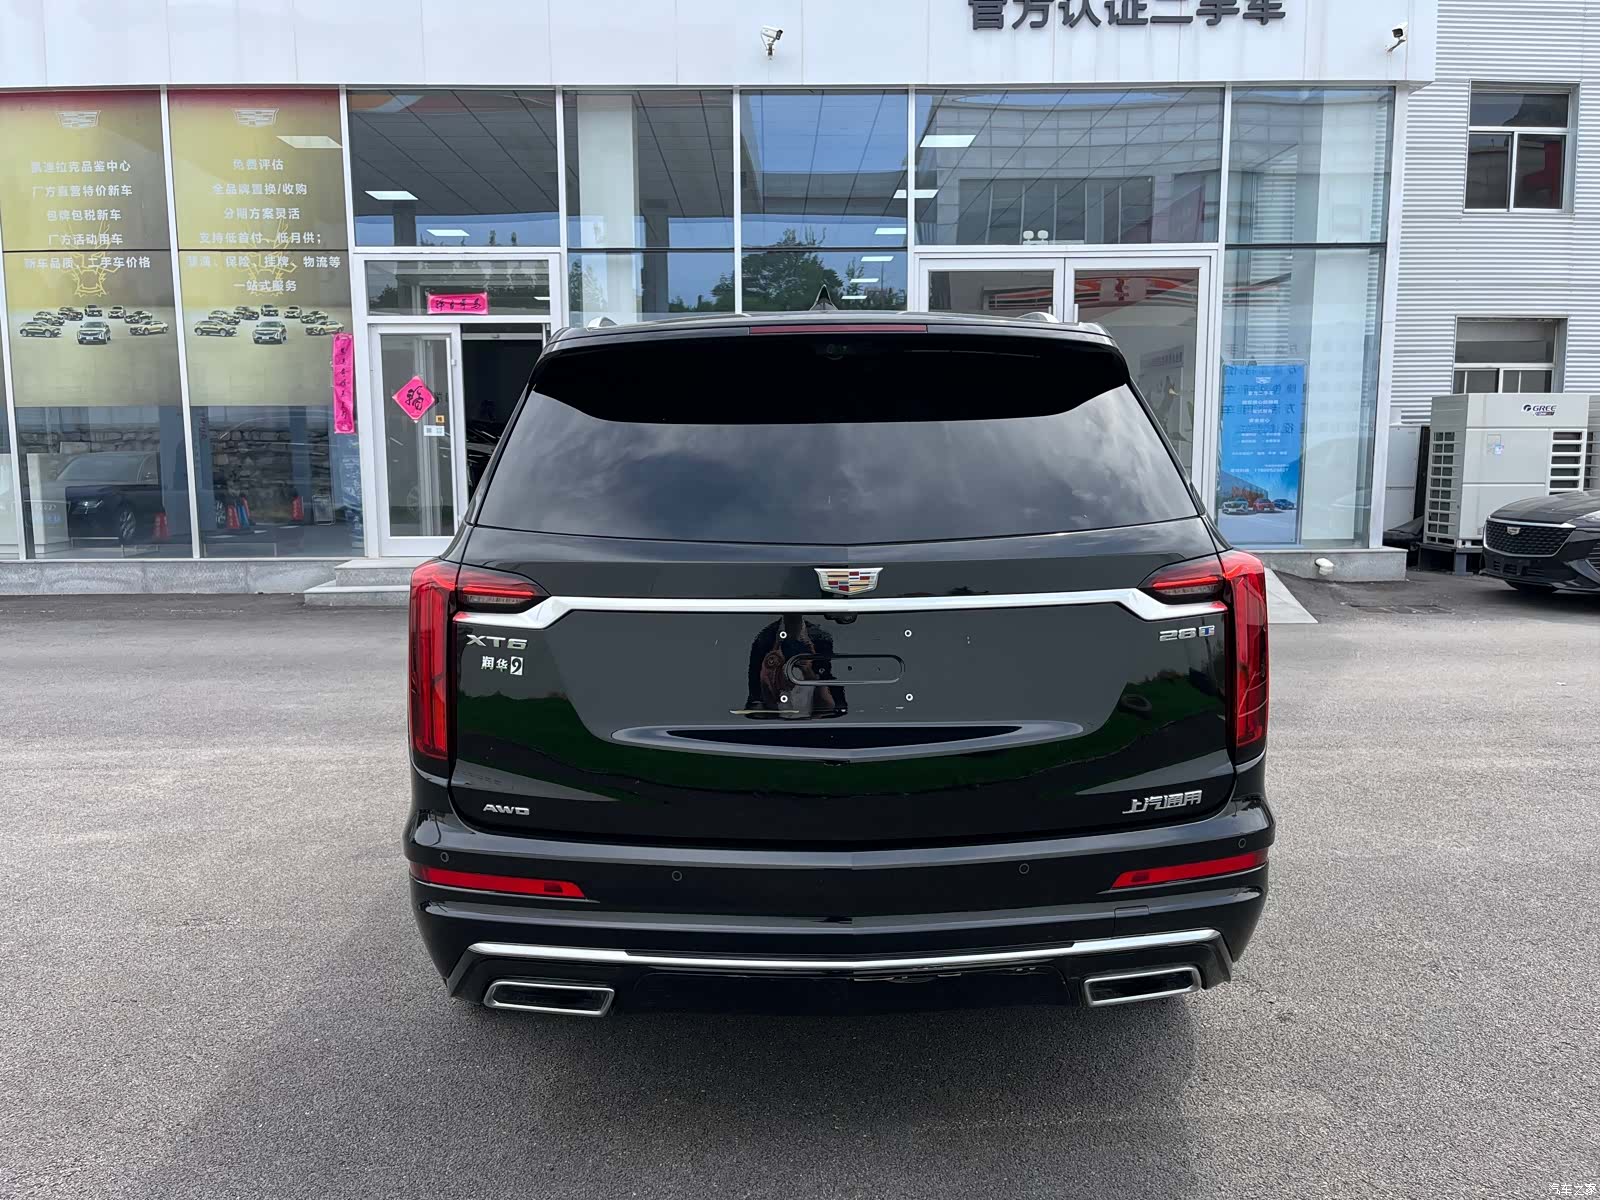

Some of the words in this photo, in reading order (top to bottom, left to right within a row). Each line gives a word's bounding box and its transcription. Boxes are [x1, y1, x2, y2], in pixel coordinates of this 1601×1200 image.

[1532, 404, 1557, 412] GREE
[1159, 625, 1215, 641] 28T
[466, 634, 528, 650] XT6
[483, 804, 530, 816] AWD
[1122, 790, 1202, 814] 上汽通用
